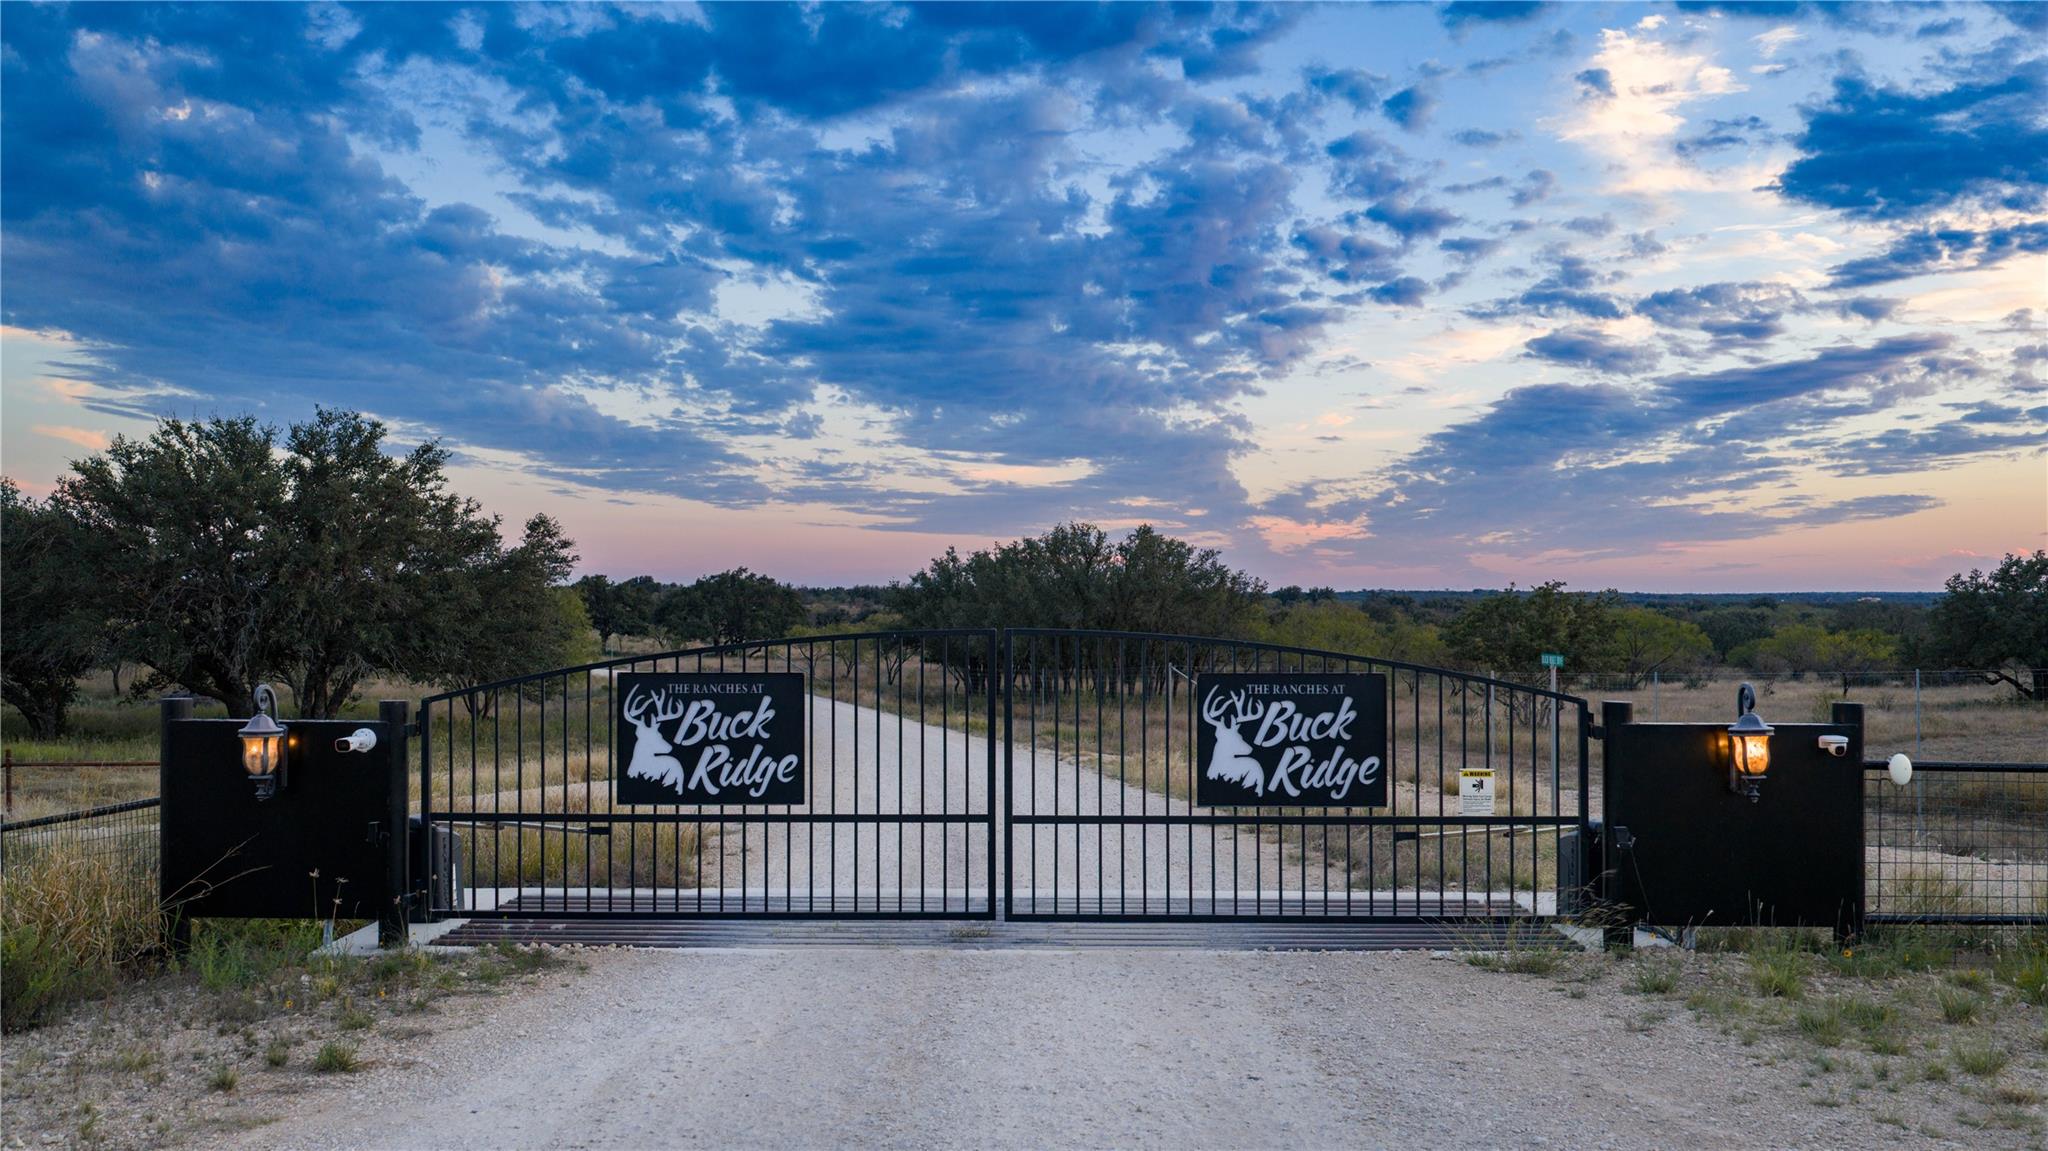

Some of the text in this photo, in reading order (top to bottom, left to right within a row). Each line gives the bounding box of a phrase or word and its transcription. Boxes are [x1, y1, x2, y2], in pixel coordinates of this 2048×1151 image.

[667, 683, 765, 694] THE RANCHES AT
[1246, 684, 1346, 695] THE RANCHES AT
[673, 695, 776, 746] Buck
[1253, 696, 1358, 748] Buck
[687, 743, 799, 798] Ridge
[1267, 745, 1380, 800] Ridge
